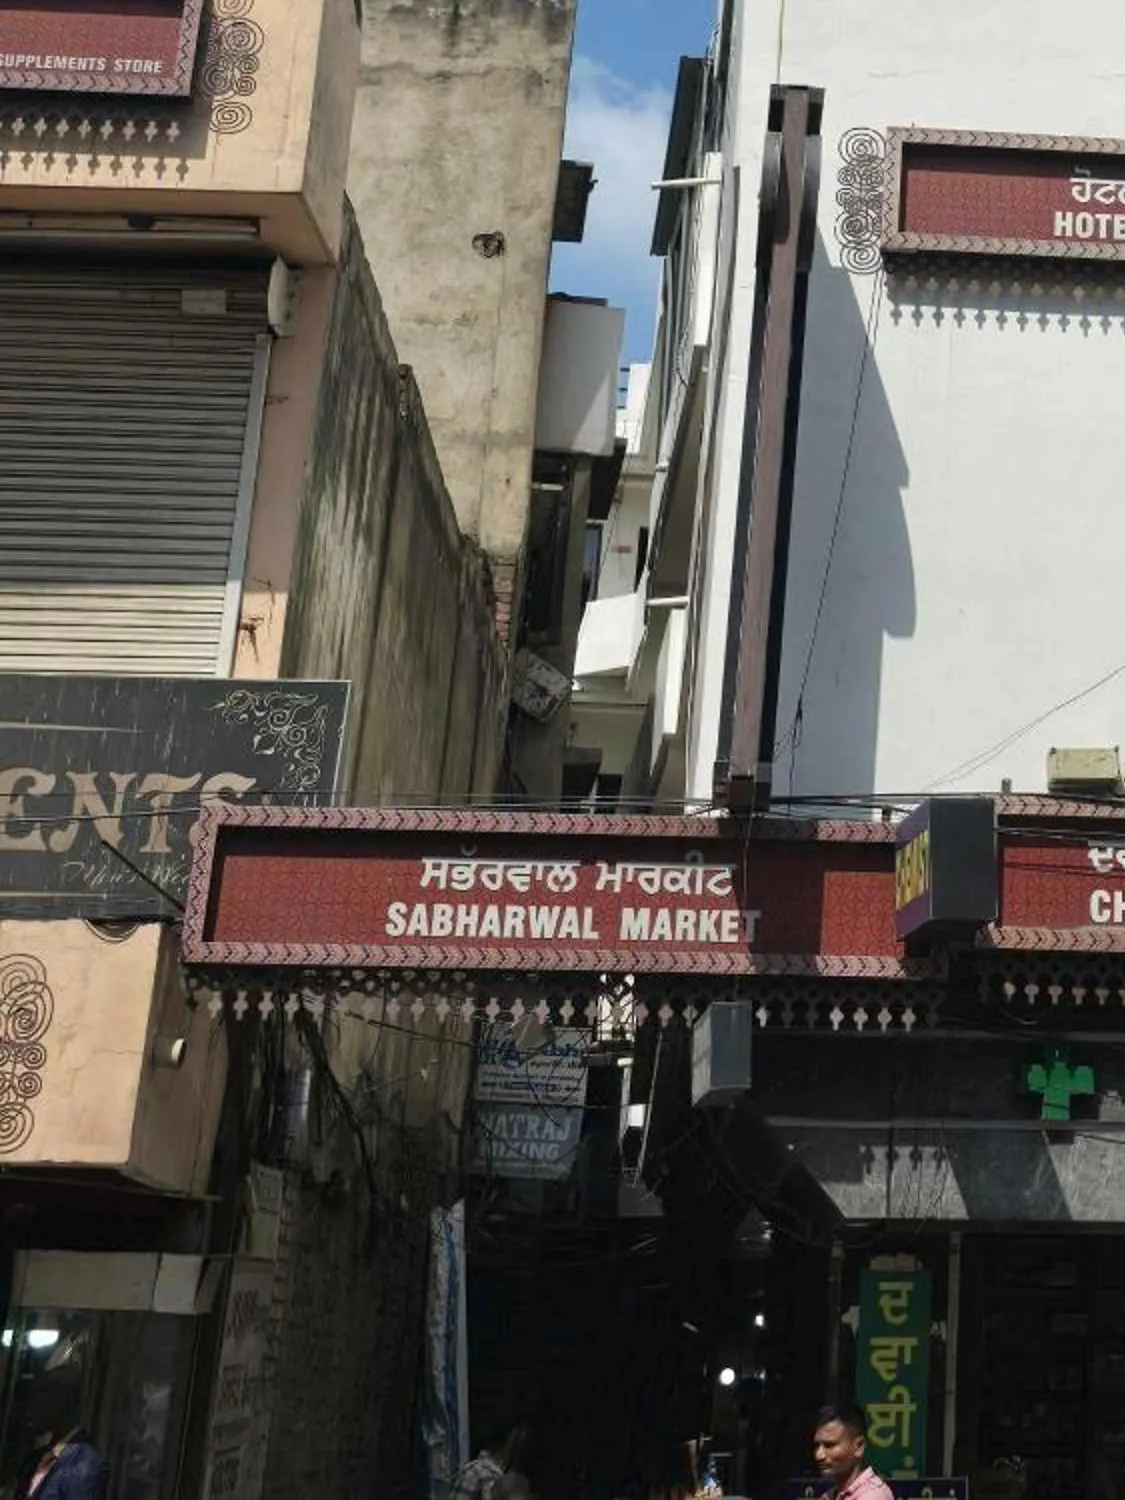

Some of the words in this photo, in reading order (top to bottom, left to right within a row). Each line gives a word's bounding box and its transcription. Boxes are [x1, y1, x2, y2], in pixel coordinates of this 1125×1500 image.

[0, 53, 106, 71] SUPPLEMENTS
[113, 58, 163, 73] STORE
[386, 902, 599, 940] SABHARWAL
[620, 907, 761, 943] MARKET
